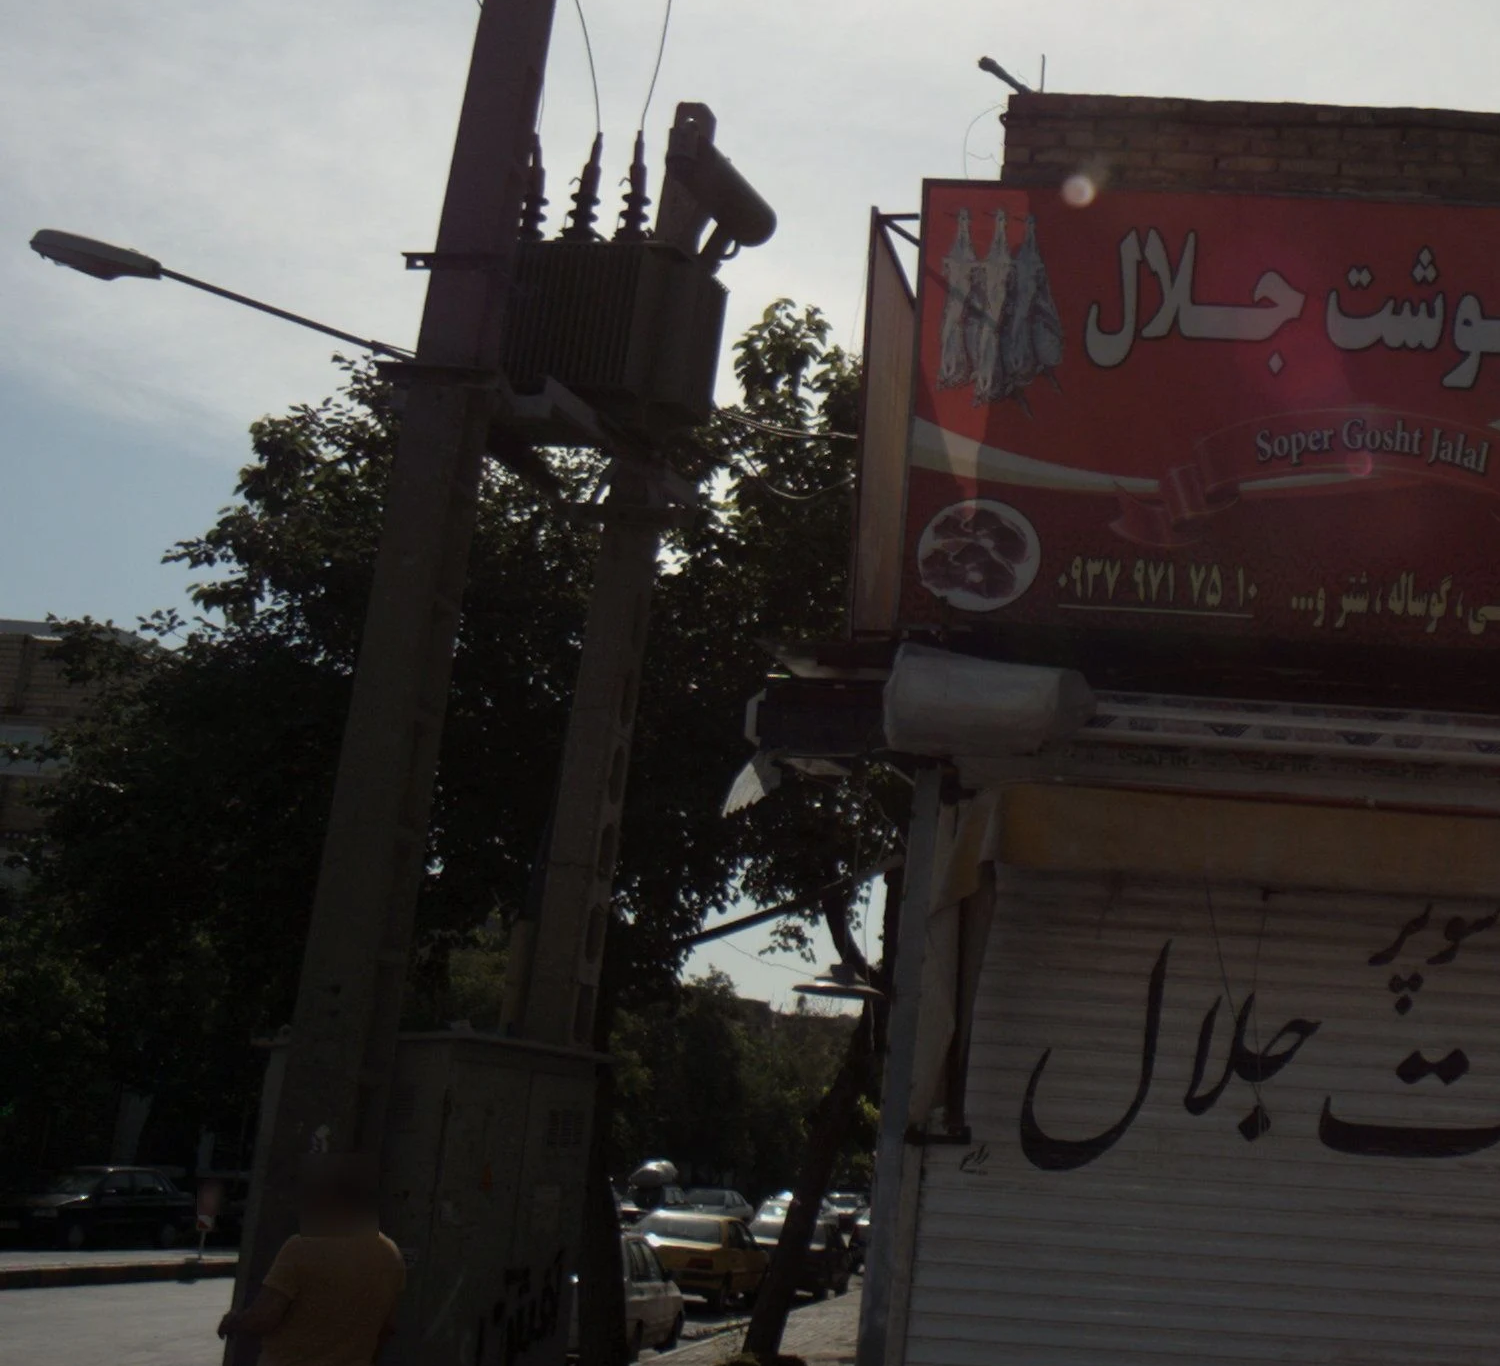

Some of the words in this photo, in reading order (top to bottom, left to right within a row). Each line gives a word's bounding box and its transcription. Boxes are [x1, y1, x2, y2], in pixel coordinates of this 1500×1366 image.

[1085, 226, 1307, 376] جلال
[1255, 427, 1336, 466] Soper
[1342, 418, 1423, 455] Gosht
[1427, 427, 1491, 476] Jalal
[1018, 939, 1322, 1172] جلال
